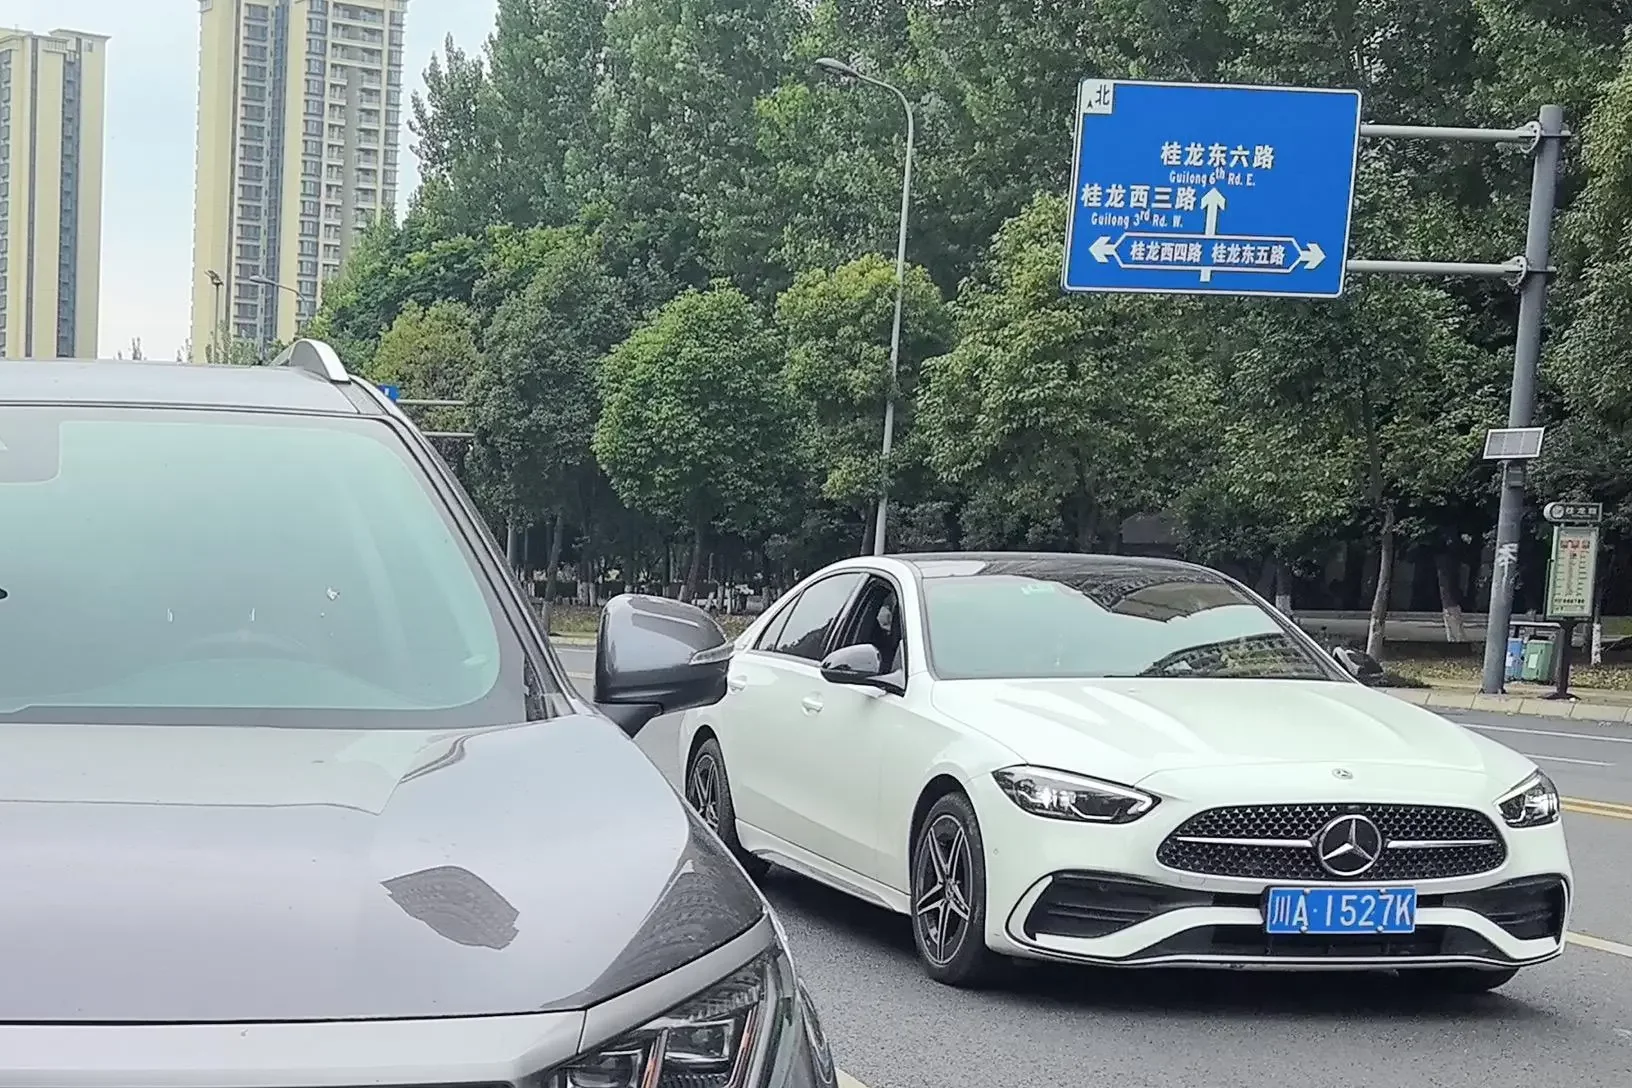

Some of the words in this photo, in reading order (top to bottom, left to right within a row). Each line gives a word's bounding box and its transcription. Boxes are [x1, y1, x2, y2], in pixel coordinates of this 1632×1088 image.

[1095, 84, 1110, 106] 北
[1161, 141, 1275, 170] 桂龙东六路
[1169, 170, 1206, 187] Guilong
[1208, 167, 1225, 185] 6th
[1228, 172, 1243, 186] Rd.
[1246, 174, 1256, 186] E.
[1081, 183, 1196, 211] 桂龙西三路
[1091, 212, 1129, 229] Guilong
[1133, 209, 1150, 226] 3rd
[1152, 214, 1168, 227] Rd.
[1173, 215, 1183, 228] W.
[1130, 241, 1203, 263] 桂龙西四路
[1211, 242, 1285, 266] 桂龙东五路
